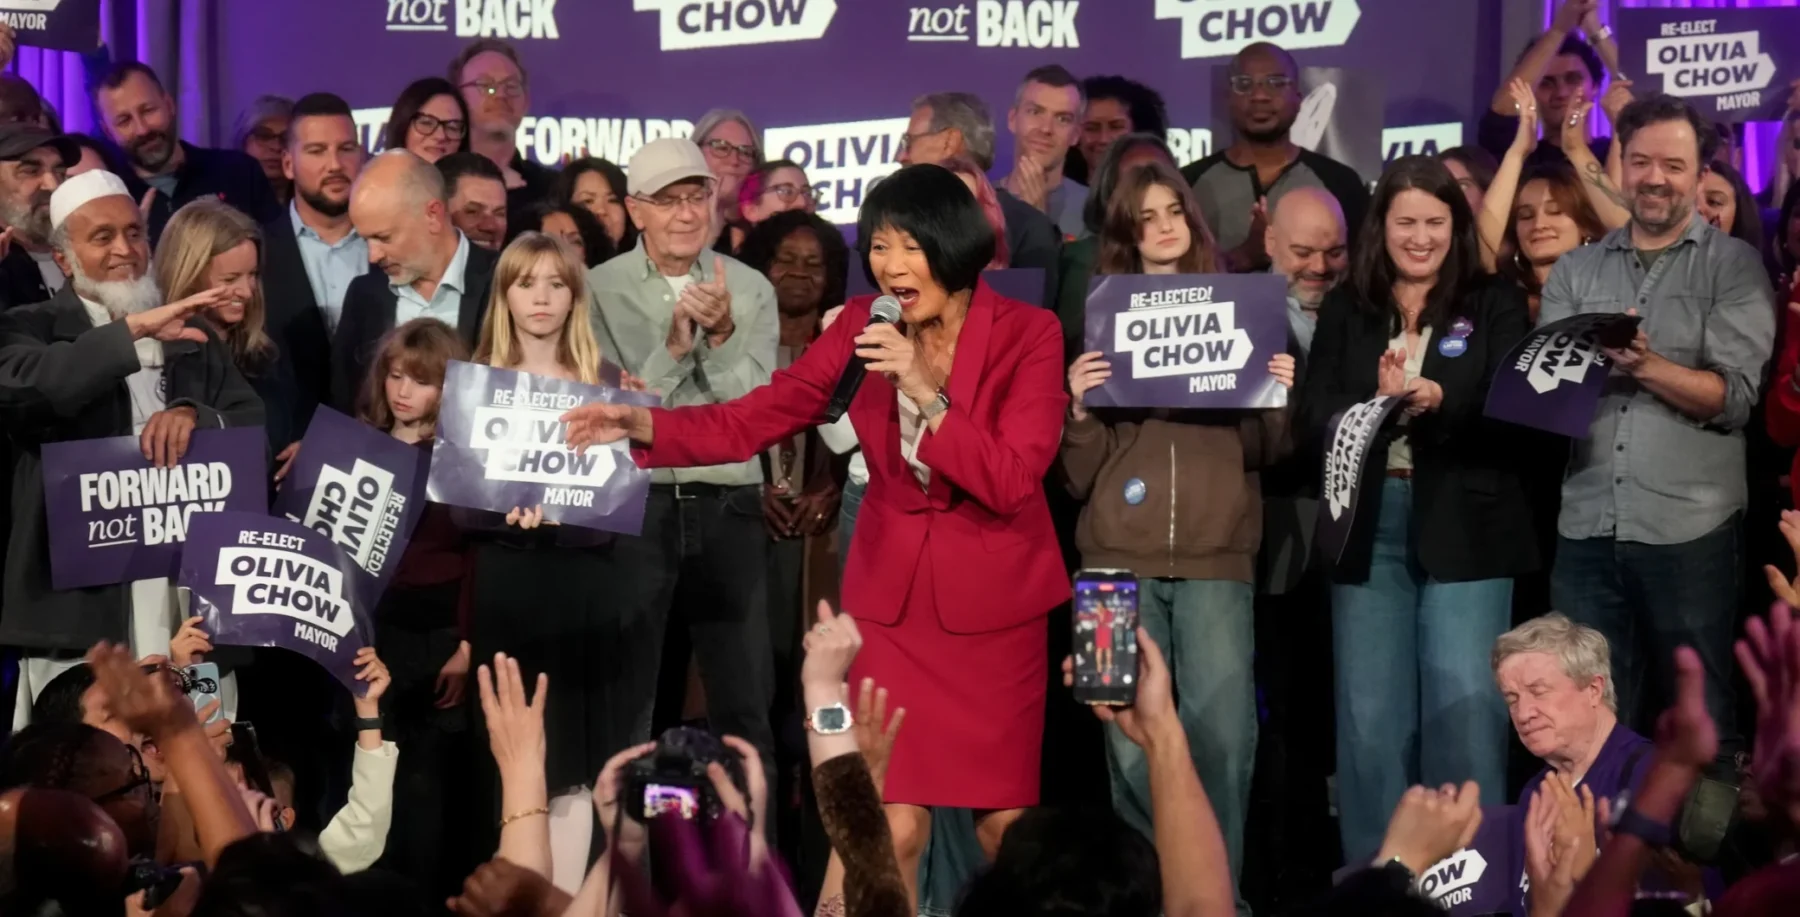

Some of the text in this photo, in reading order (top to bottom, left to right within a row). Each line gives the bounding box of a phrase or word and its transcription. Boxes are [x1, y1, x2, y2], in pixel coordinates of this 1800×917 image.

[386, 0, 560, 38] not BACK
[677, 0, 808, 34] CHOW
[908, 0, 1080, 48] not BACK
[1198, 1, 1333, 42] CHOW
[1660, 19, 1717, 36] RE-ELECT
[1658, 41, 1747, 64] OLIVIA
[1674, 63, 1759, 88] CHOW
[1716, 92, 1761, 111] MAYOR
[783, 134, 901, 170] OLIVI
[1130, 286, 1213, 308] RE-ELECTED!
[1126, 312, 1222, 341] OLIVIA
[1143, 339, 1235, 368] CHOW
[1514, 334, 1549, 372] MAYOR
[1189, 373, 1237, 393] MAYOR
[1333, 411, 1356, 503] CHOW
[1341, 401, 1376, 492] OLIVIA
[80, 461, 232, 512] FORWARD
[543, 487, 595, 507] MAYOR
[88, 514, 138, 541] not
[338, 476, 380, 557] OLIVI
[238, 530, 306, 551] RE-ELECT
[366, 491, 406, 577] RE-ELECTED!
[230, 555, 331, 595] OLIVIA
[246, 583, 341, 623] CHOW
[294, 622, 338, 653] MAYOR
